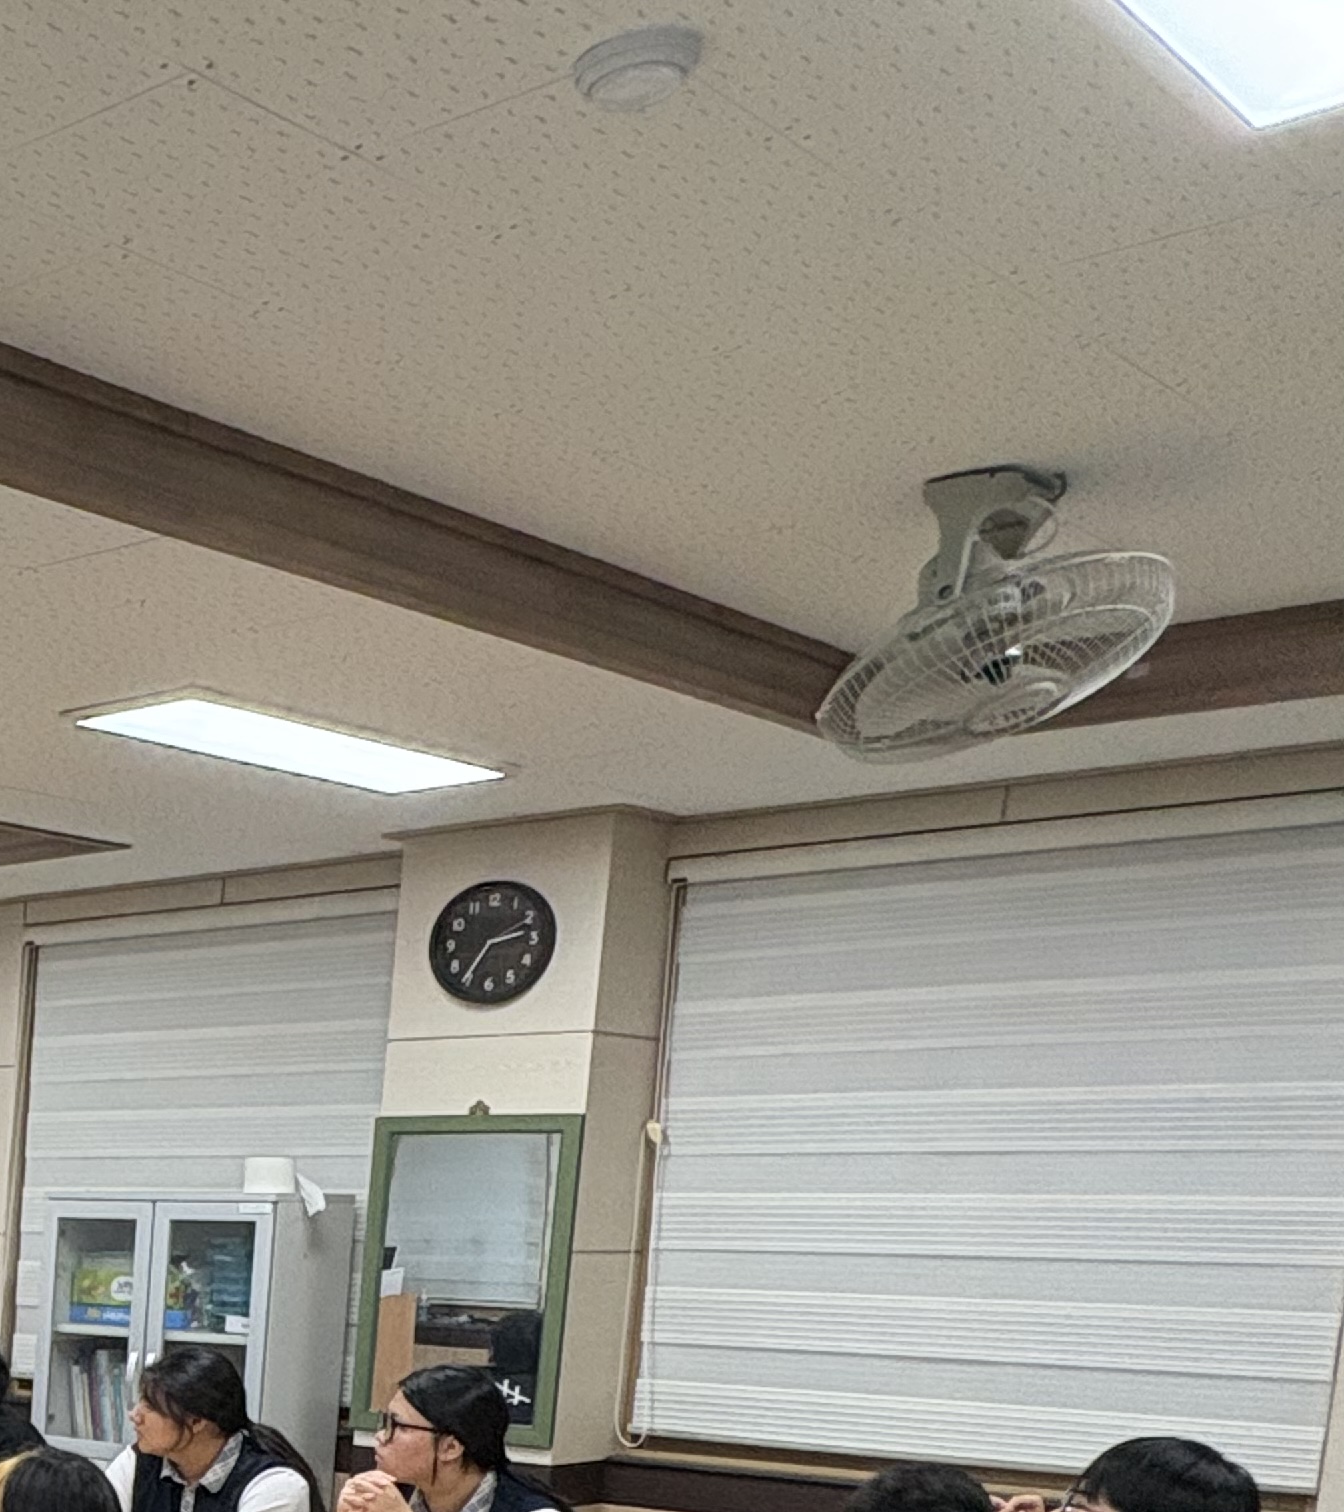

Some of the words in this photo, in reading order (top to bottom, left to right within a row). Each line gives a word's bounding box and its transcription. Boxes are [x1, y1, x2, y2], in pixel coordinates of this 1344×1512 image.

[529, 931, 539, 945] 3
[447, 940, 455, 953] 9
[521, 954, 531, 967] 4
[505, 969, 515, 984] 5
[484, 977, 494, 991] 6
